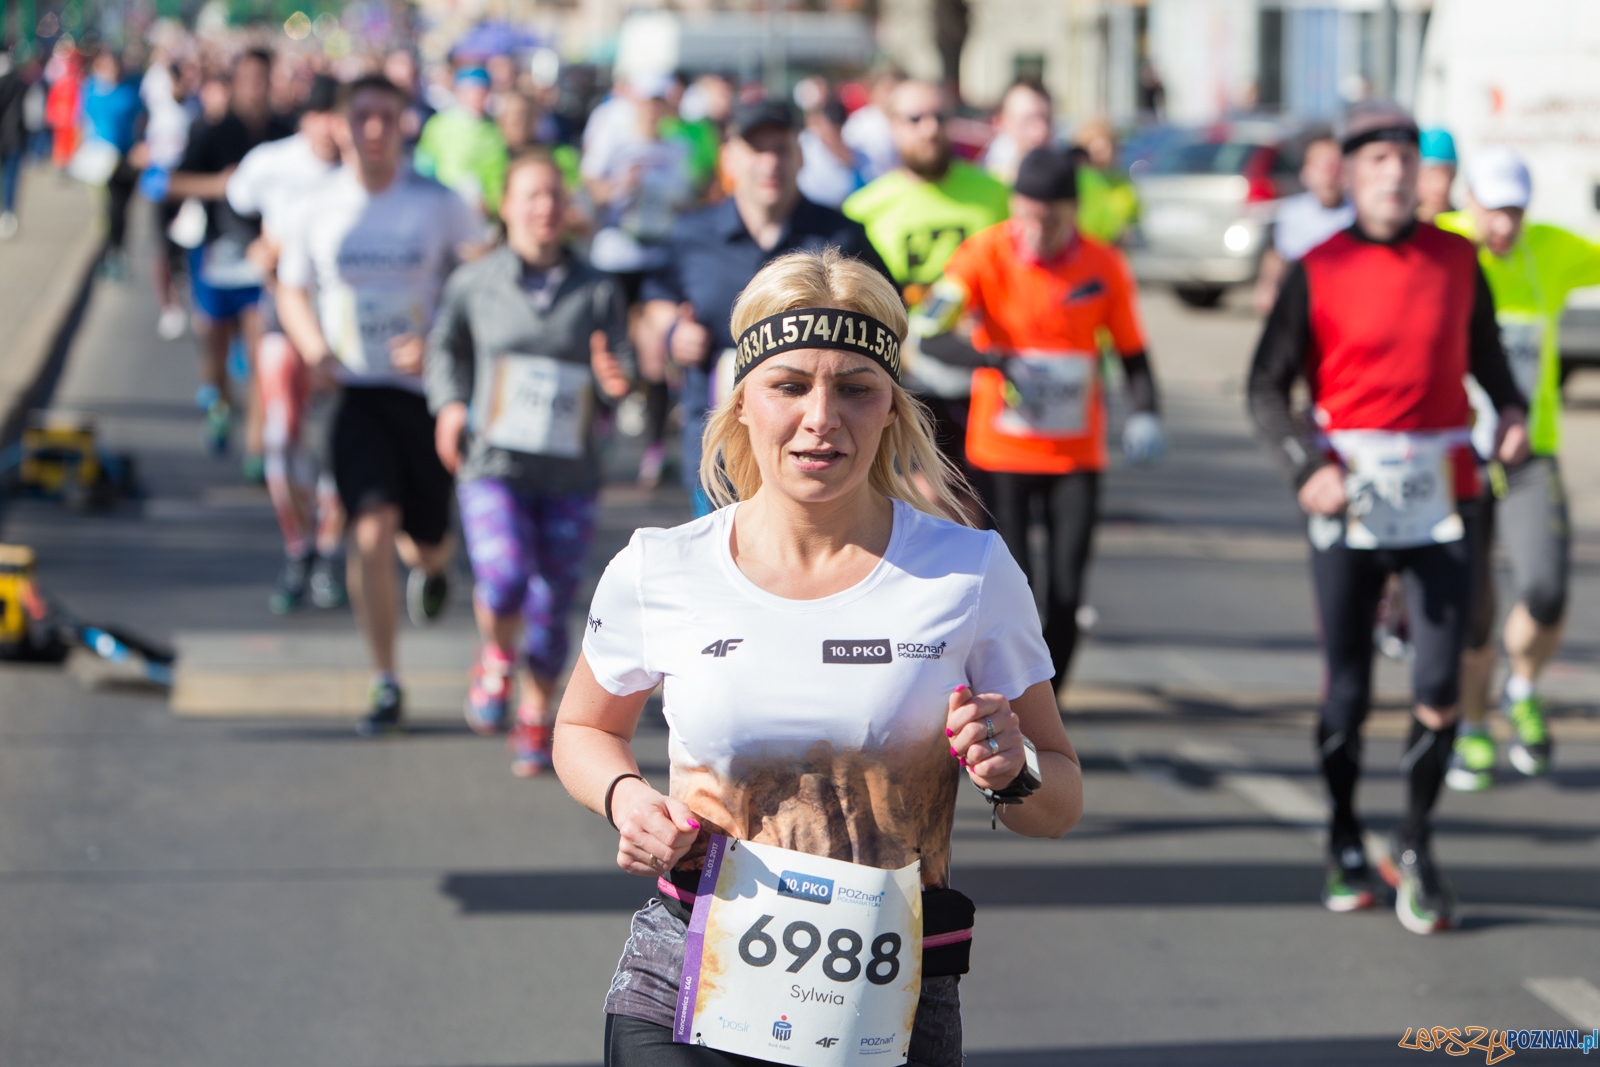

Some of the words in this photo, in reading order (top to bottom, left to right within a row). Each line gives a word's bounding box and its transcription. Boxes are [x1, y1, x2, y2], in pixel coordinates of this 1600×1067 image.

[701, 638, 744, 657] 4F
[829, 645, 850, 657] 10.
[853, 645, 886, 657] PKO
[705, 843, 719, 878] 26.03.2017
[785, 877, 800, 892] 10.
[801, 881, 829, 897] PKO
[738, 914, 902, 986] 6988
[684, 976, 692, 990] K40
[790, 984, 845, 1005] Sylwia
[815, 1037, 840, 1048] 4F
